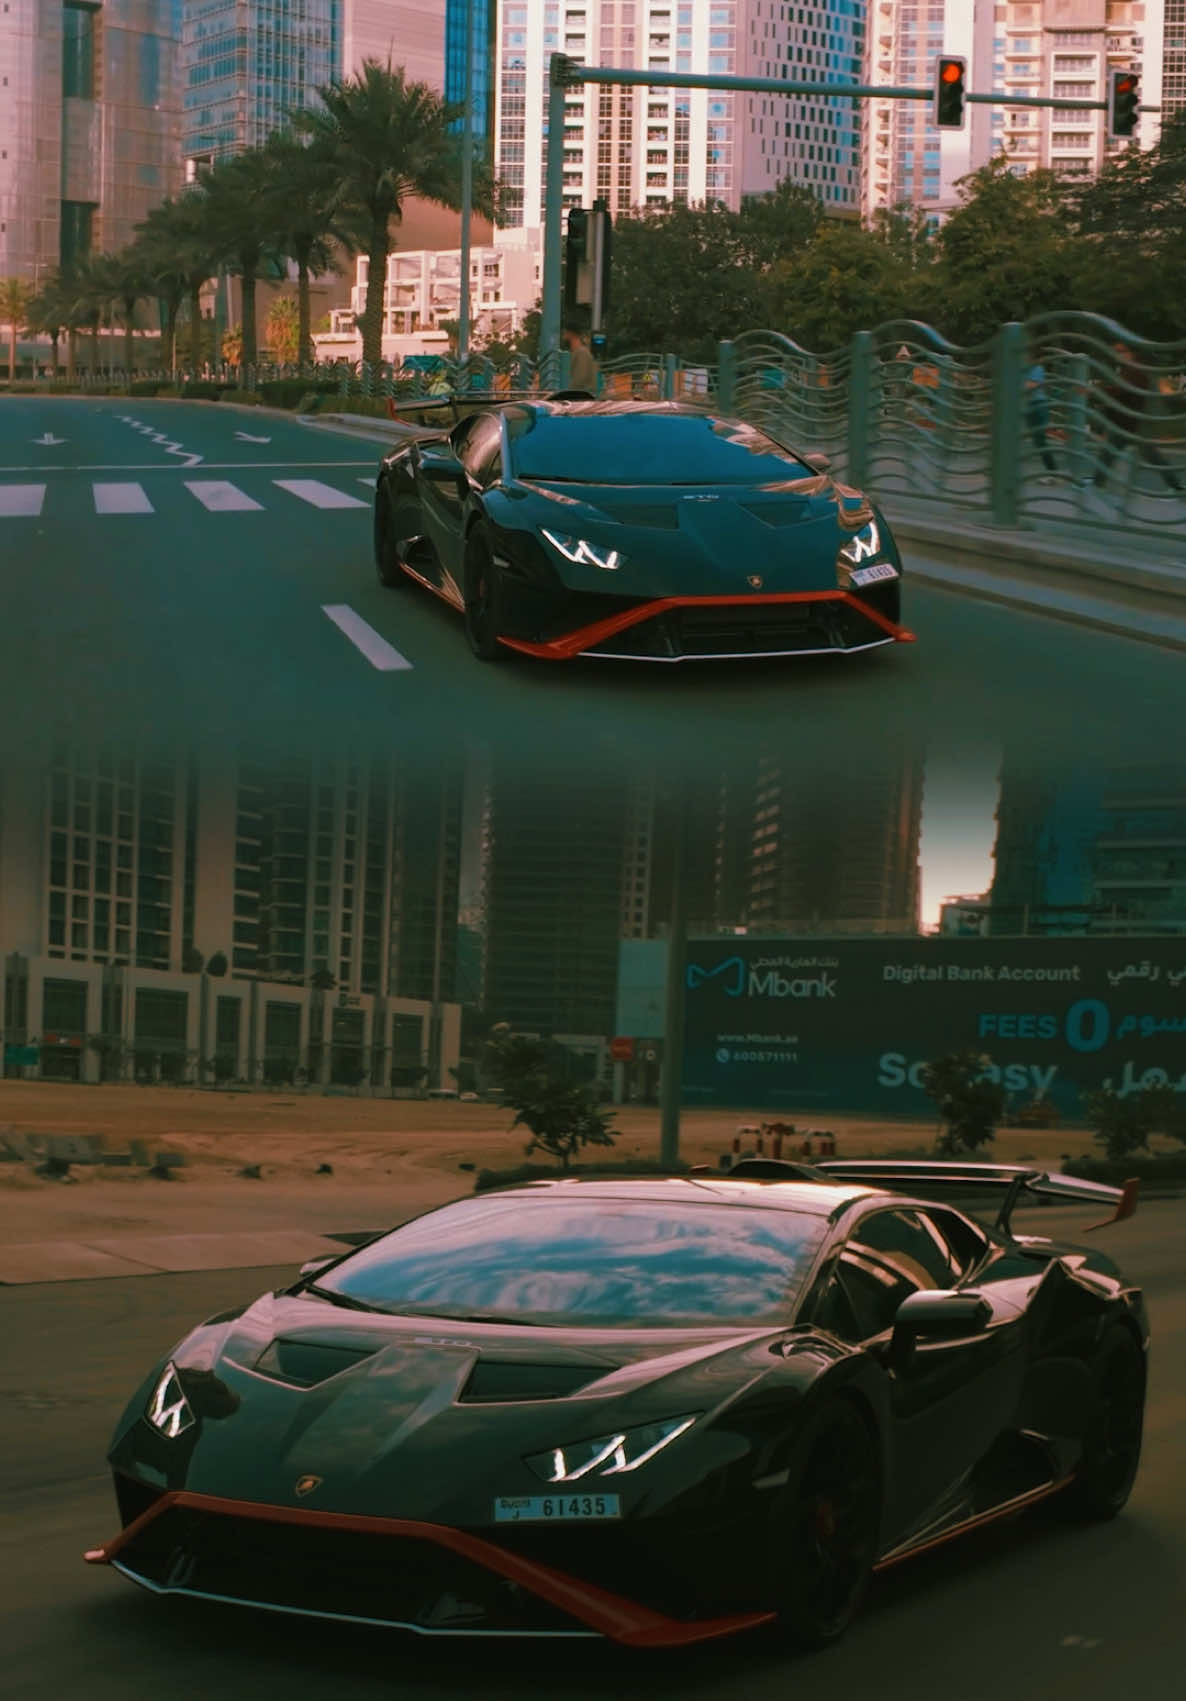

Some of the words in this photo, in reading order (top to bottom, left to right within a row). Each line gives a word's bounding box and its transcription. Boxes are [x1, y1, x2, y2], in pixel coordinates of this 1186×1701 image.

[748, 971, 837, 998] Mbank
[883, 965, 941, 984] Digital
[947, 965, 994, 981] Bank
[996, 965, 1080, 981] Account
[1107, 960, 1160, 987] رقمي
[979, 1014, 1058, 1039] FEES
[1066, 998, 1110, 1053] 0
[1116, 1015, 1186, 1041] سوم
[973, 1063, 1059, 1101] asy
[543, 1497, 606, 1517] 61435
